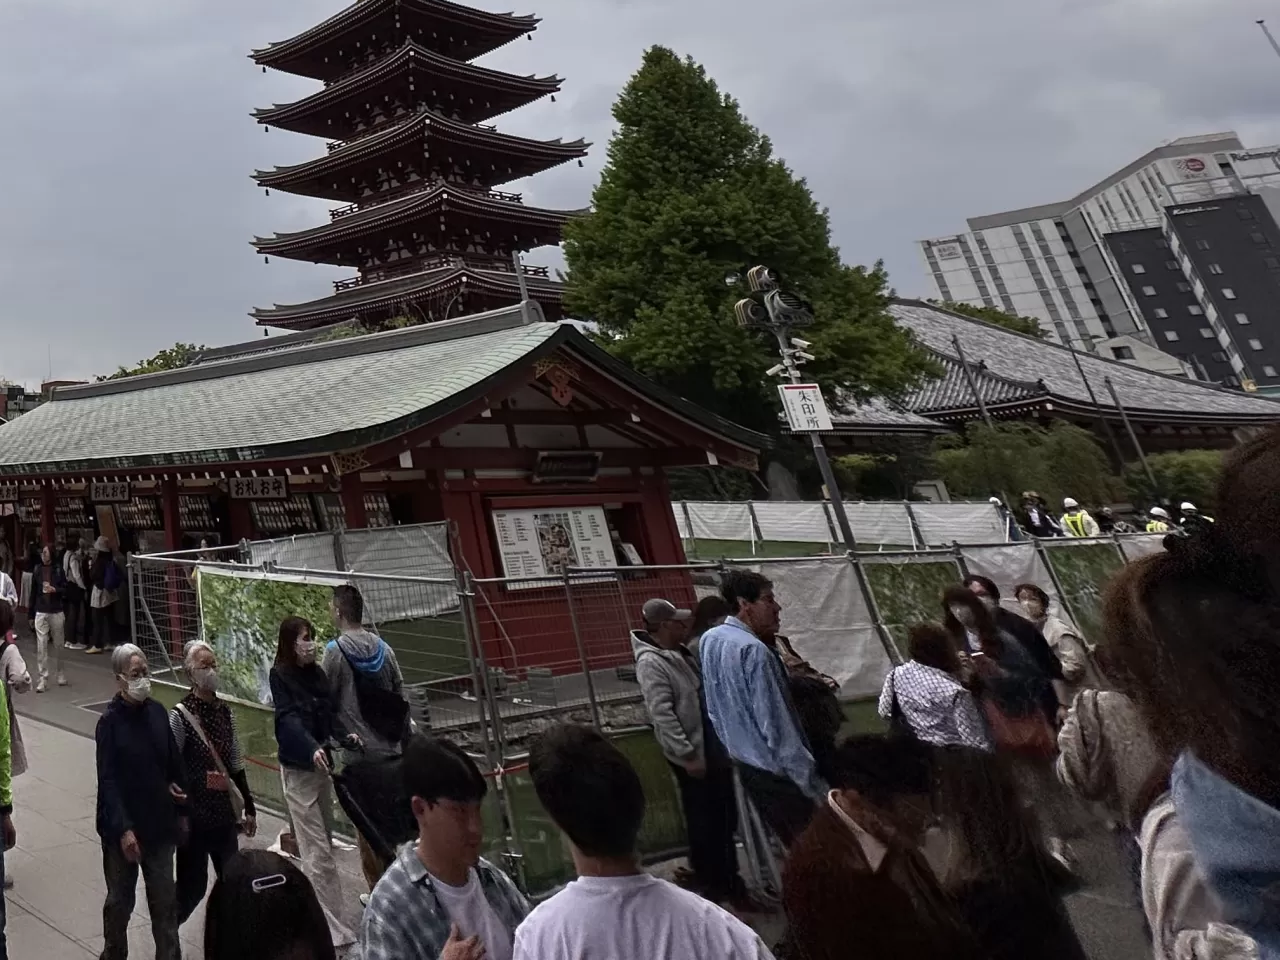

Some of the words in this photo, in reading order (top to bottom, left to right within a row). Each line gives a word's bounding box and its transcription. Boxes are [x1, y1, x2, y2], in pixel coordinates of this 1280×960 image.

[799, 390, 819, 428] 朱印所
[235, 479, 283, 496] お札お守
